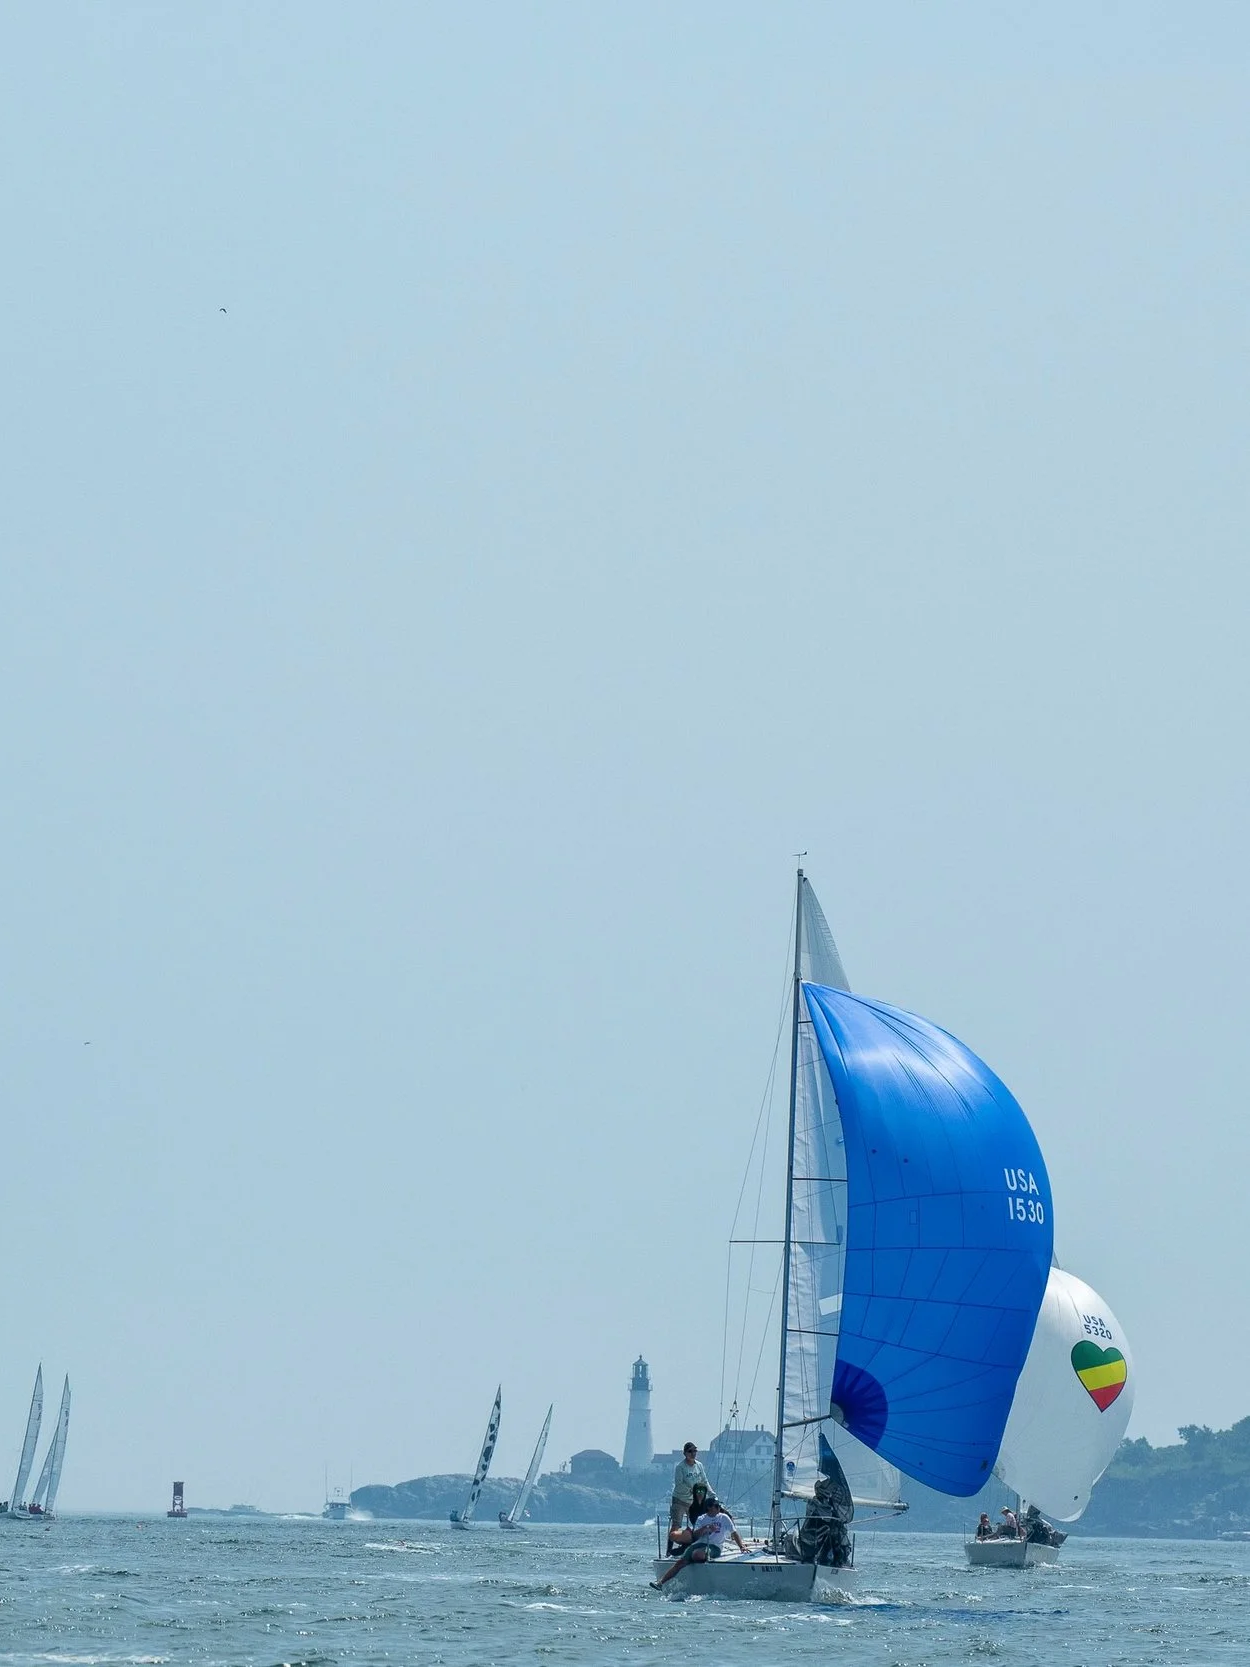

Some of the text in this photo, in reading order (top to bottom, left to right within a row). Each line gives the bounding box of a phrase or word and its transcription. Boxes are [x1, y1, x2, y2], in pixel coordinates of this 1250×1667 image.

[1004, 1168, 1039, 1196] USA
[1008, 1196, 1044, 1225] 1530
[1083, 1314, 1106, 1328] USA
[1083, 1324, 1113, 1340] 5320
